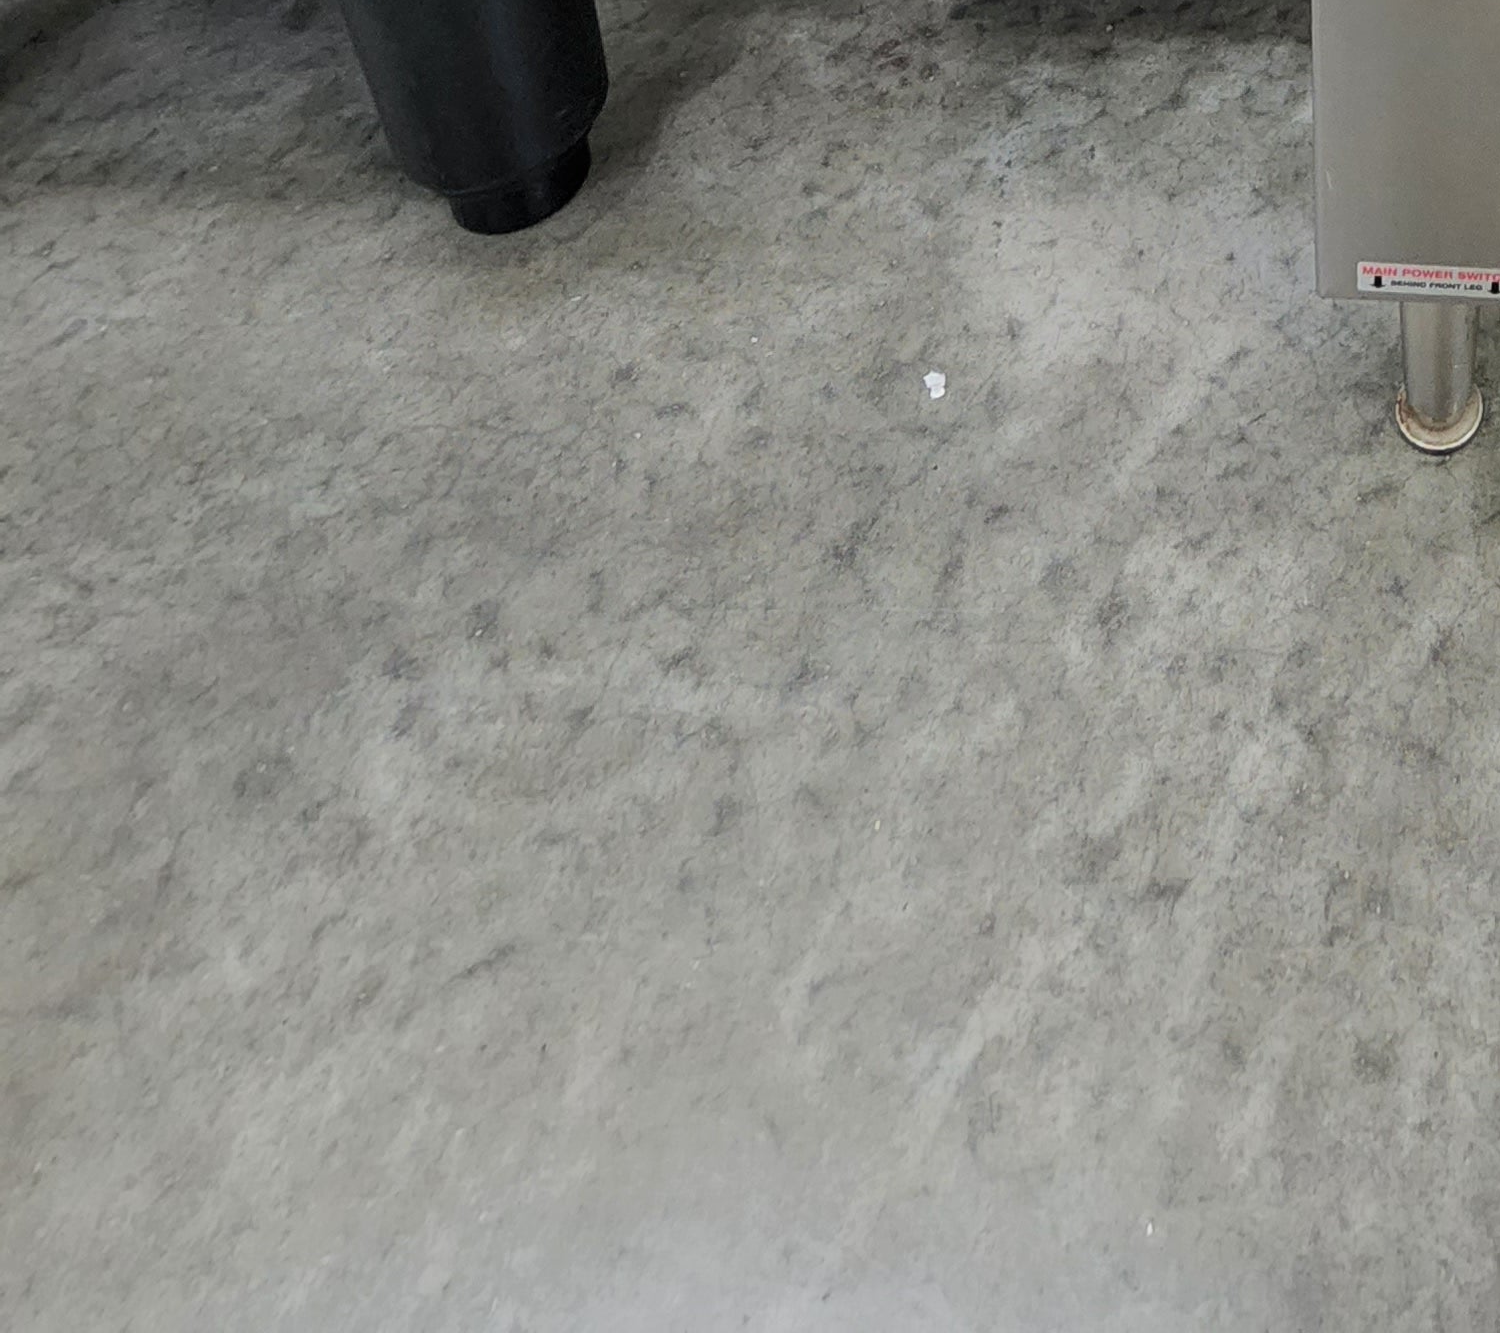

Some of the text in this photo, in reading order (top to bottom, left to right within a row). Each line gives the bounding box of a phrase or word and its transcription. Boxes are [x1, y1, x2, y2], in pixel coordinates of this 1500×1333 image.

[1362, 266, 1398, 277] MAIN
[1402, 269, 1453, 280] POWER
[1464, 283, 1483, 291] LEG
